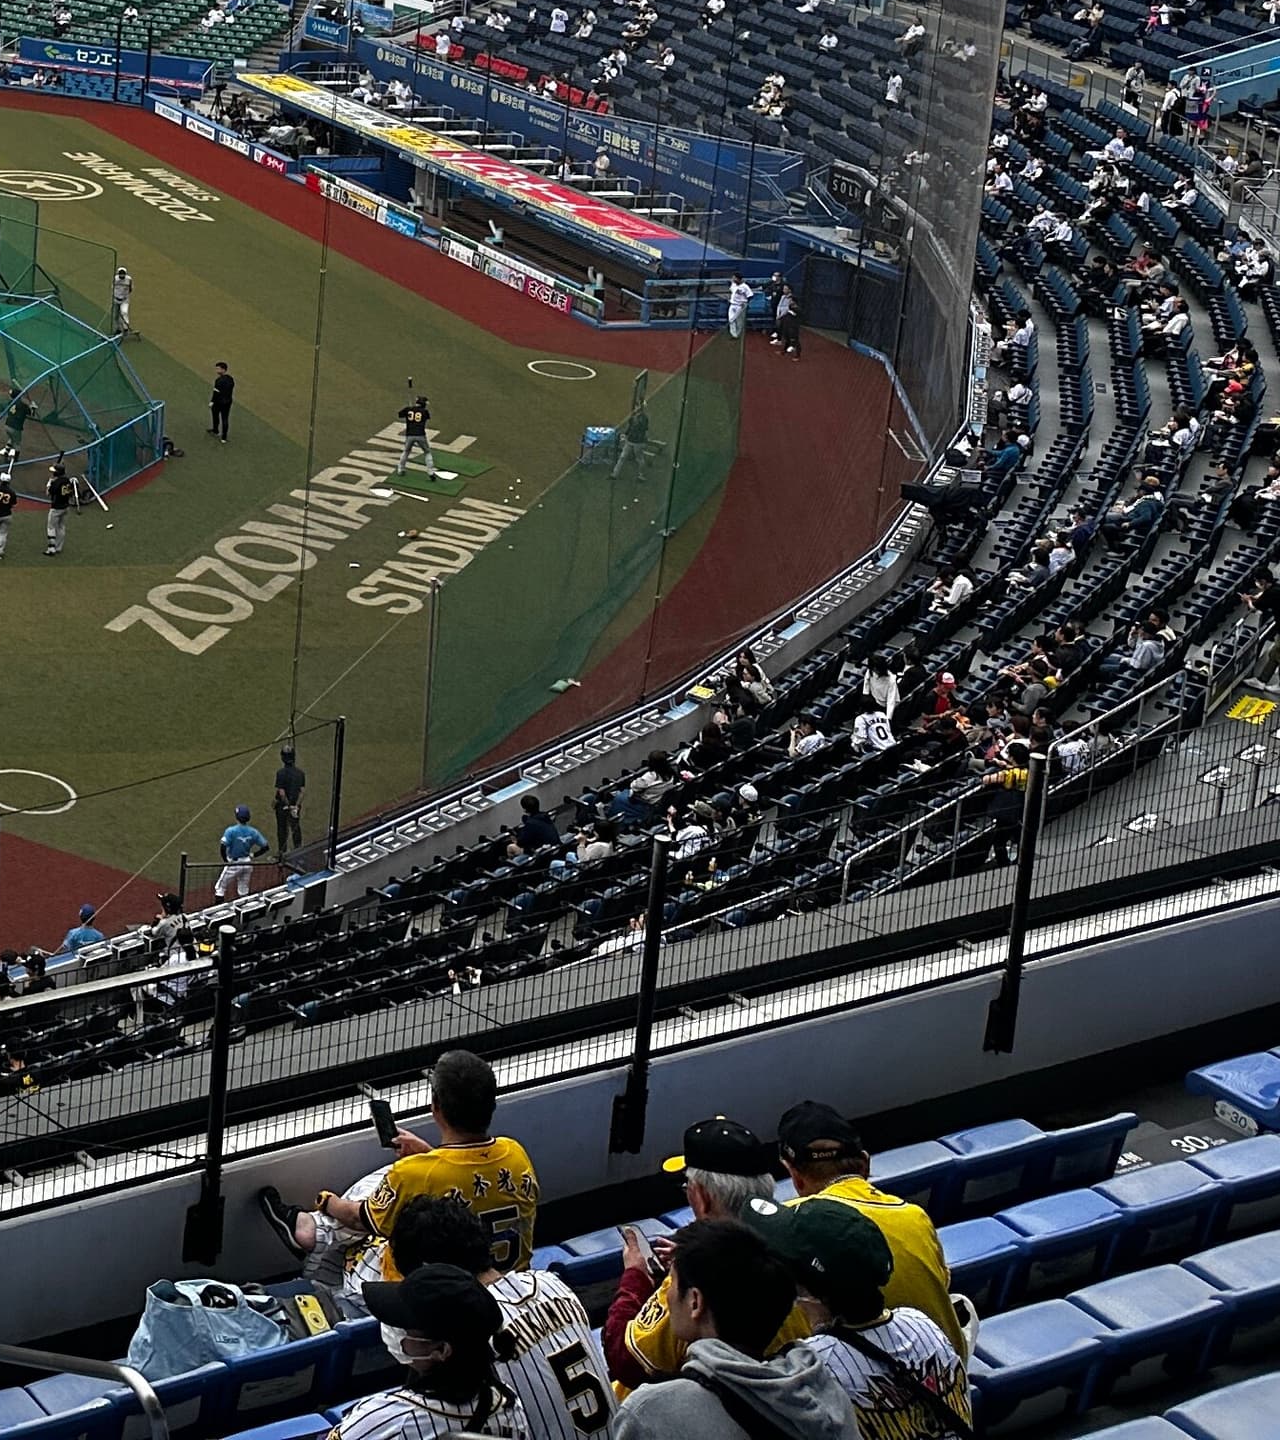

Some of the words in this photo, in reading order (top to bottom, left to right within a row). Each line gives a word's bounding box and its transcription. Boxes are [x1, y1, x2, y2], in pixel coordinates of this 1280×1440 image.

[407, 411, 422, 423] 38
[346, 498, 528, 615] STADIUM
[1170, 1135, 1210, 1154] 30
[545, 1339, 610, 1435] 5
